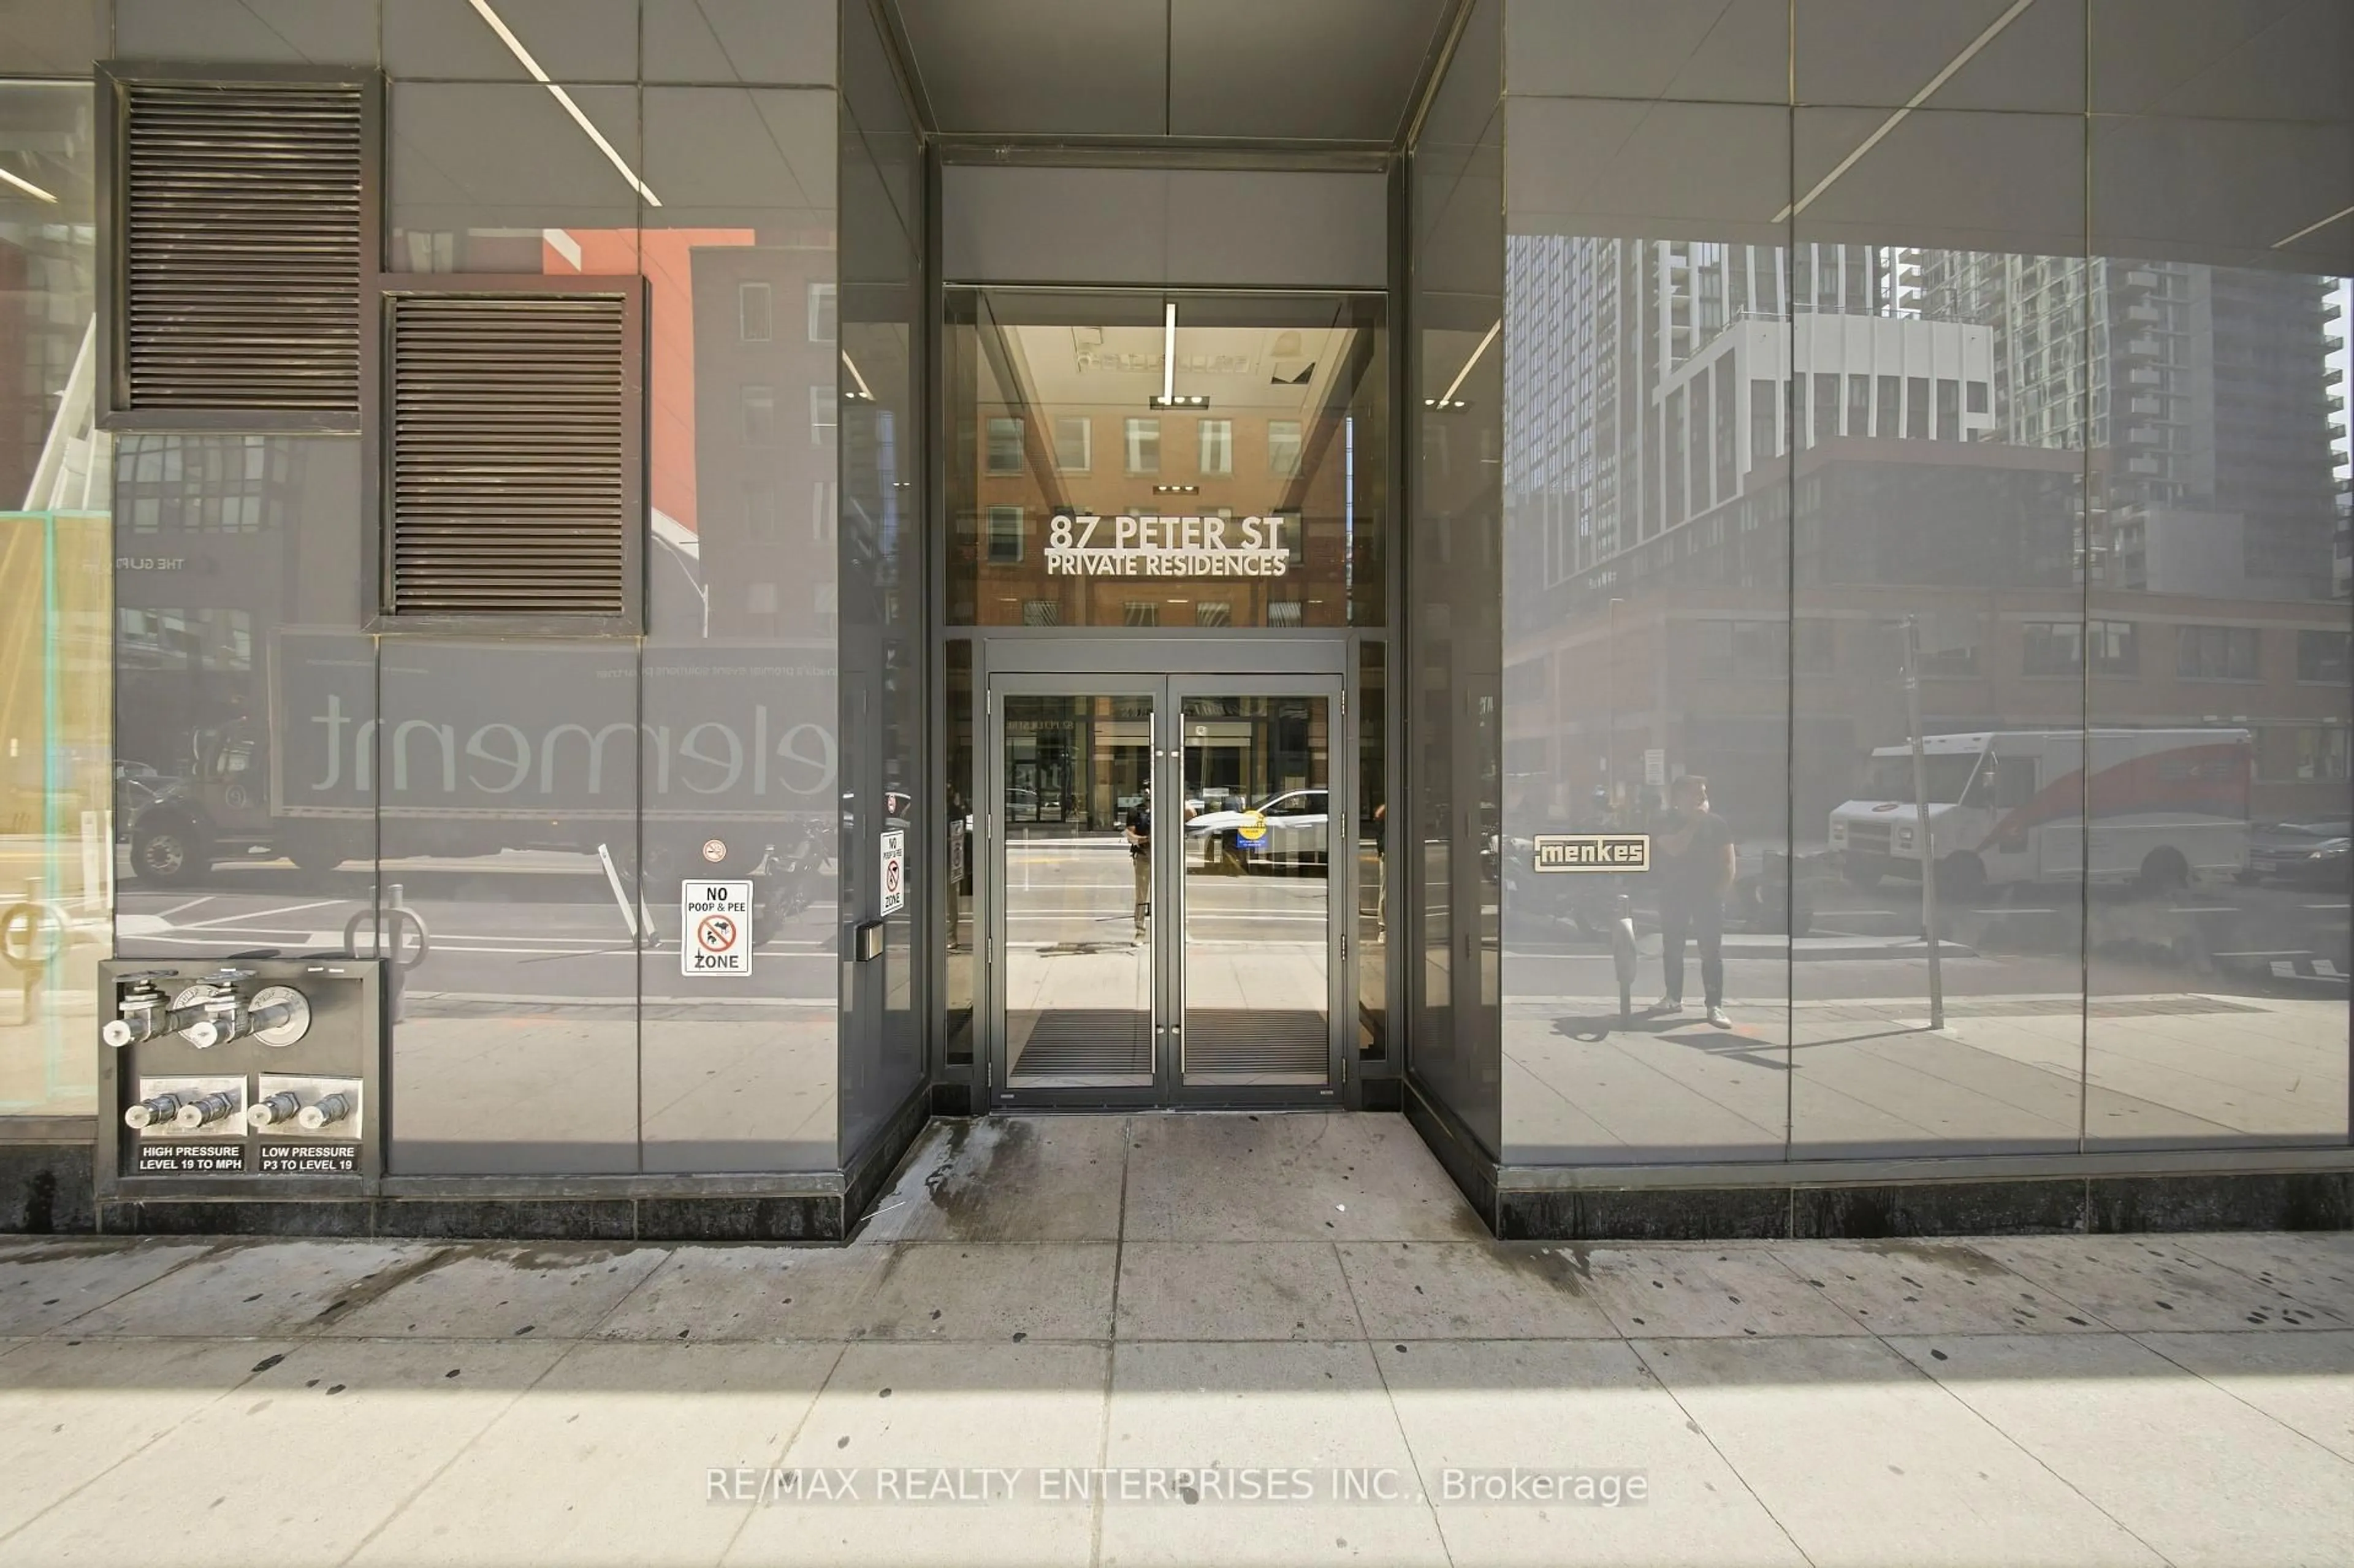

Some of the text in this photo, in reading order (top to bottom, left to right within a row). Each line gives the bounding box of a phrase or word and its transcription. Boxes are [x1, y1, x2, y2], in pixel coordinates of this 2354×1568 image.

[1049, 516, 1284, 549] 87 PETER ST
[1047, 554, 1286, 577] PRIVATE RESIDENCES
[889, 837, 897, 849] NO
[1541, 839, 1644, 862] menkes
[707, 888, 728, 901] NO
[885, 892, 900, 908] ZONE
[688, 902, 745, 912] POOP & PEE
[694, 955, 739, 969] ZONE
[143, 1147, 240, 1157] HIGH PRESSURE
[262, 1147, 354, 1157] LOW PRESSURE
[140, 1159, 242, 1170] LEVEL 19 TO MPH
[263, 1160, 353, 1170] P3 TO LEVEL 19
